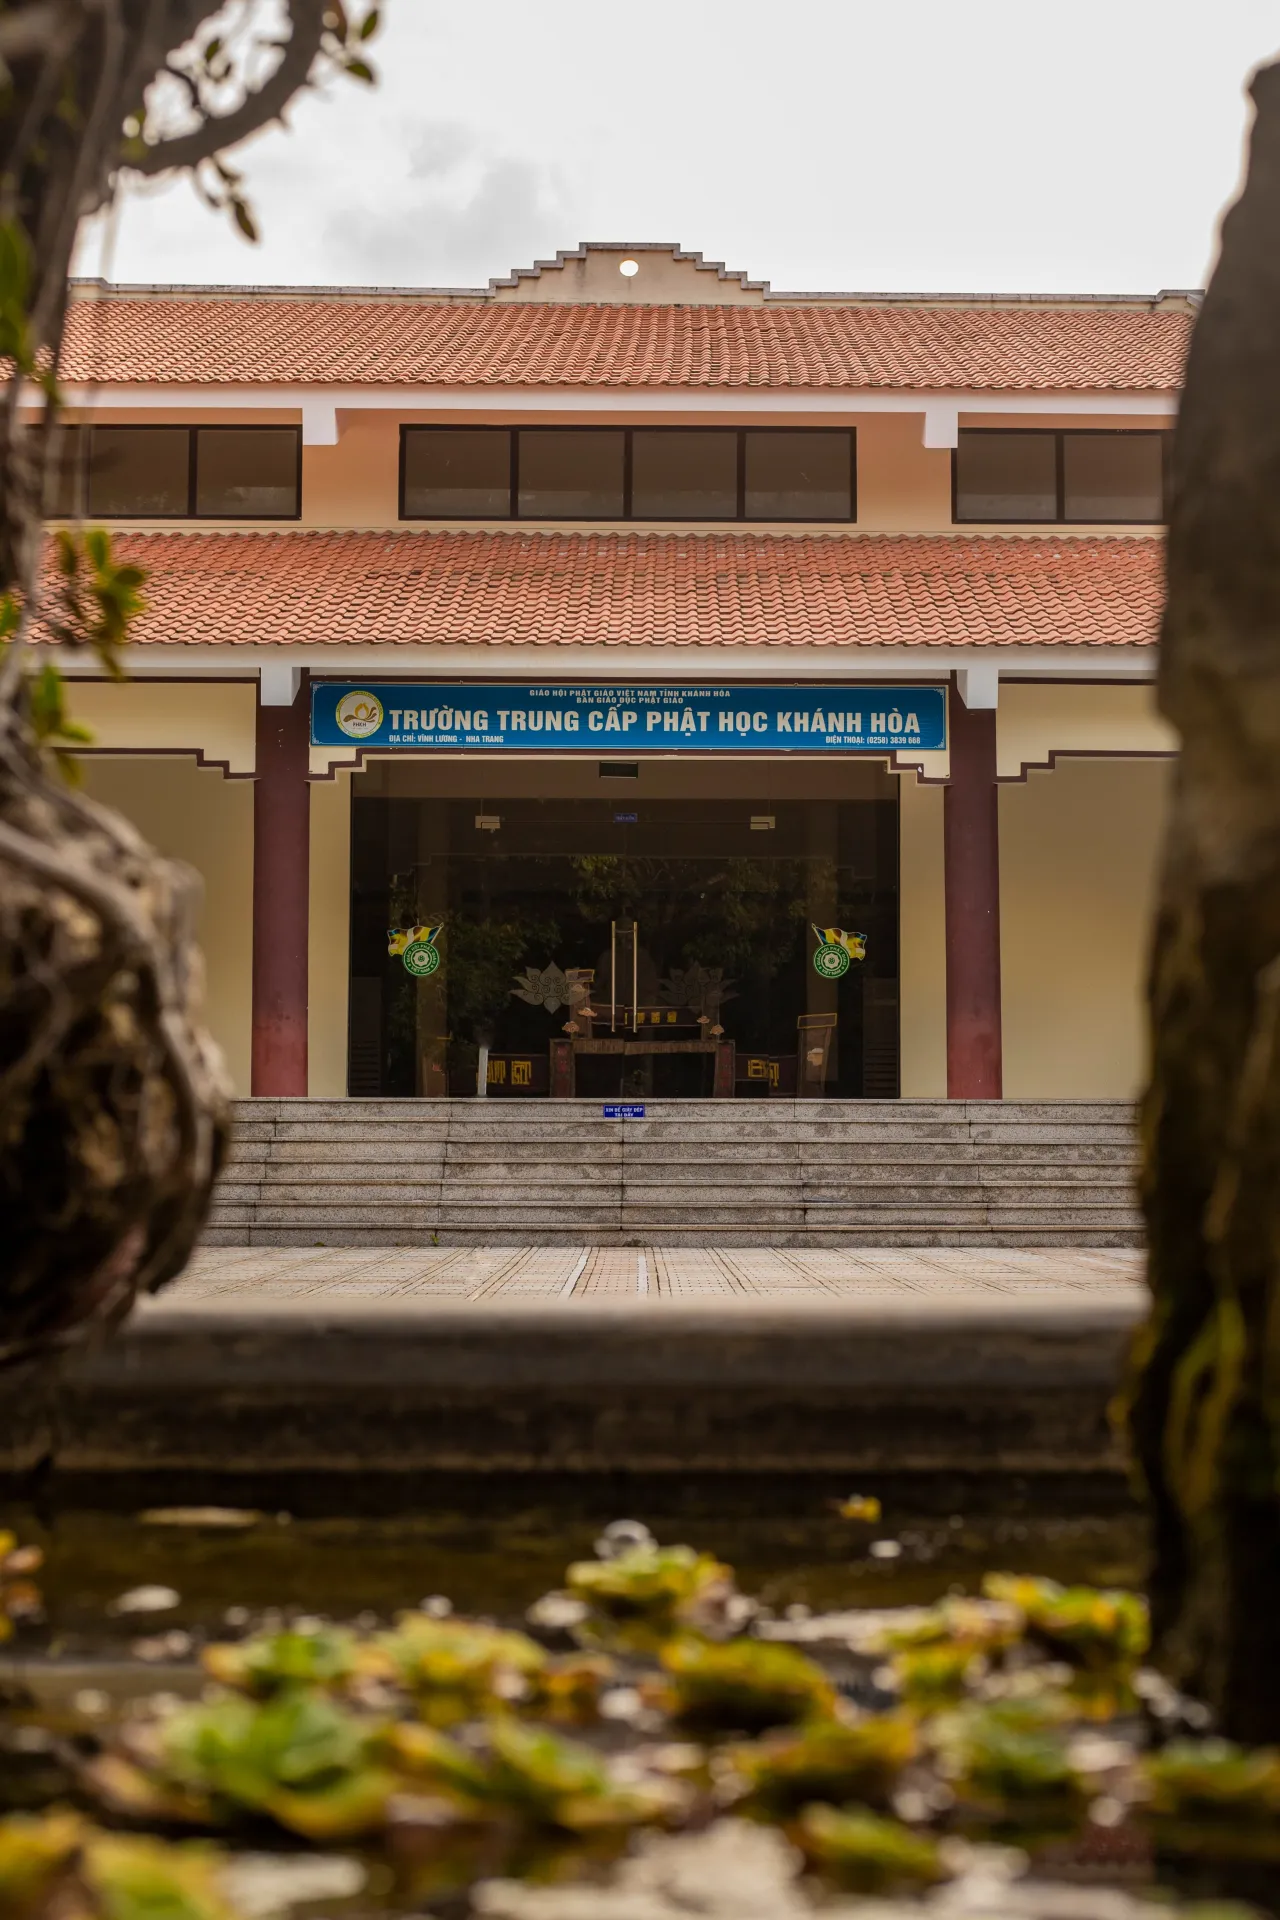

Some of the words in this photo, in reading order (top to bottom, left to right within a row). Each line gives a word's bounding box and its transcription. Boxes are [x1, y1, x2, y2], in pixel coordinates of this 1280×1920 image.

[552, 689, 567, 698] HỘI
[569, 689, 591, 698] PHẬT
[594, 689, 614, 697] GIÁO
[616, 689, 635, 698] VIỆT
[681, 689, 711, 697] KHÁNH
[596, 696, 617, 704] GIÁO
[639, 697, 661, 705] PHẬT
[663, 696, 684, 704] GIÁO
[389, 704, 489, 731] TRƯỜNG
[497, 710, 579, 732] TRUNG
[588, 703, 638, 732] CẤP
[646, 706, 710, 736] PHẬT
[718, 711, 768, 736] HỌC
[777, 708, 862, 733] KHÁNH
[871, 707, 921, 734] HÒA
[388, 734, 401, 743] ĐỊA
[465, 735, 480, 743] NHA
[482, 735, 504, 743] TRANG
[825, 734, 843, 745] ĐIỆN
[843, 736, 865, 745] THOẠI:
[866, 736, 889, 744] (0258)
[890, 736, 907, 744] 3839
